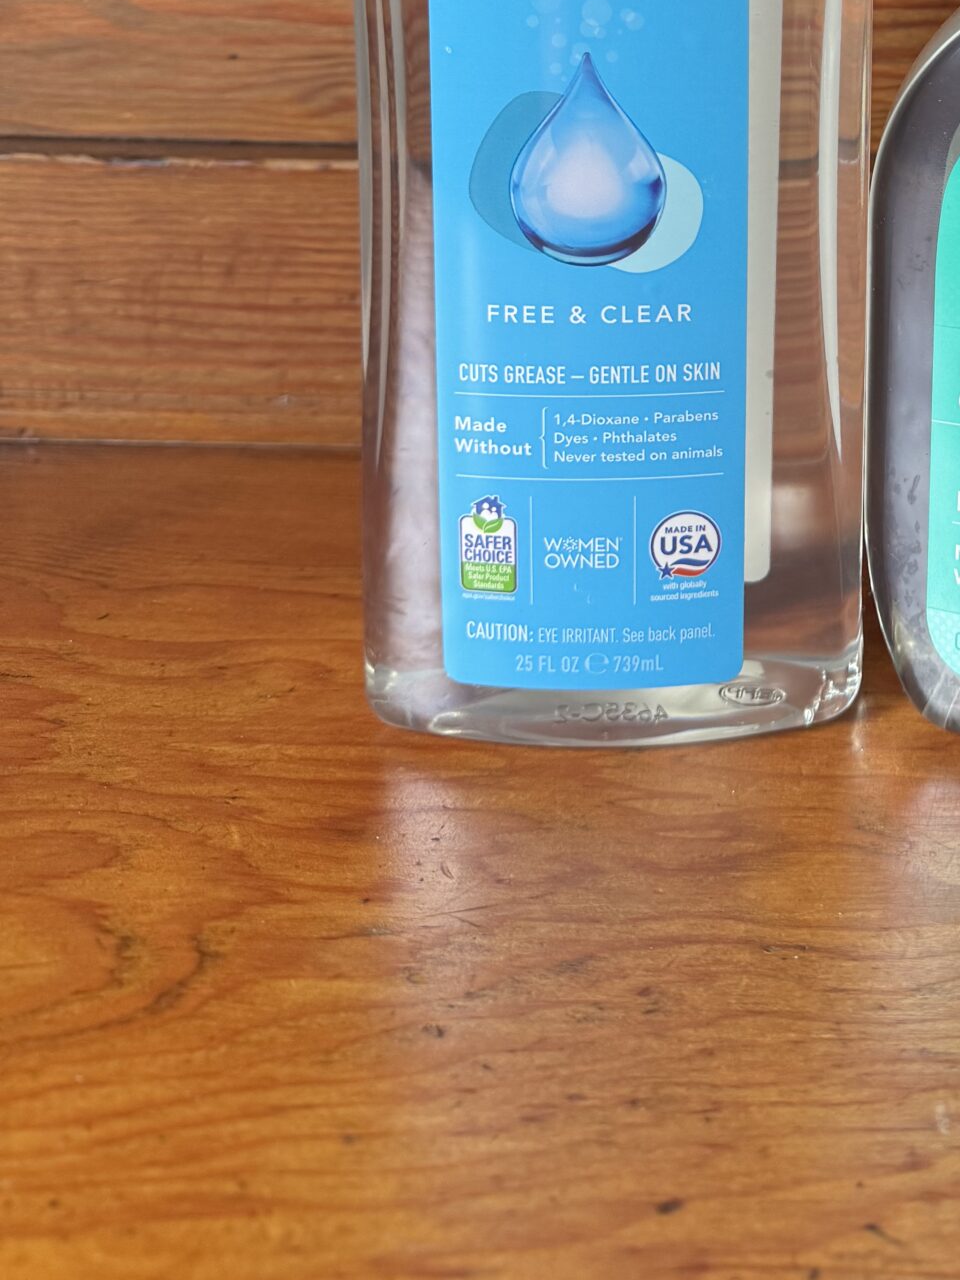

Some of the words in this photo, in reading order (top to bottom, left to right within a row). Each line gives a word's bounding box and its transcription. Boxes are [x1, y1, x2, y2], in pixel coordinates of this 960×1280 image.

[487, 304, 556, 325] FREE
[568, 305, 587, 325] &
[600, 303, 693, 325] CLEAR
[458, 363, 499, 384] CUTS
[503, 365, 567, 385] GREASE
[589, 364, 650, 385] GENTLE
[654, 364, 678, 383] ON
[682, 361, 721, 382] SKIN
[454, 415, 508, 433] Made
[554, 413, 640, 428] 1,4-Dioxane
[653, 409, 719, 425] Parabens
[454, 437, 532, 457] Without
[553, 431, 589, 448] Dyes
[602, 431, 677, 445] Phthalates
[553, 449, 596, 464] Never
[600, 449, 646, 464] tested
[649, 450, 668, 462] on
[671, 445, 724, 461] animals
[664, 524, 693, 535] MADE
[695, 524, 706, 532] IN
[464, 533, 512, 551] SAFER
[660, 533, 713, 556] USA
[464, 548, 513, 564] CHOICE
[544, 552, 620, 569] OWNED
[465, 620, 535, 643] CAUTION:
[538, 626, 559, 643] EYE
[562, 627, 619, 644] IRRITANT.
[622, 629, 646, 644] See
[648, 624, 677, 642] back
[679, 622, 717, 644] panel.
[515, 654, 534, 672] 25
[538, 654, 555, 673] FL
[561, 655, 580, 673] OZ
